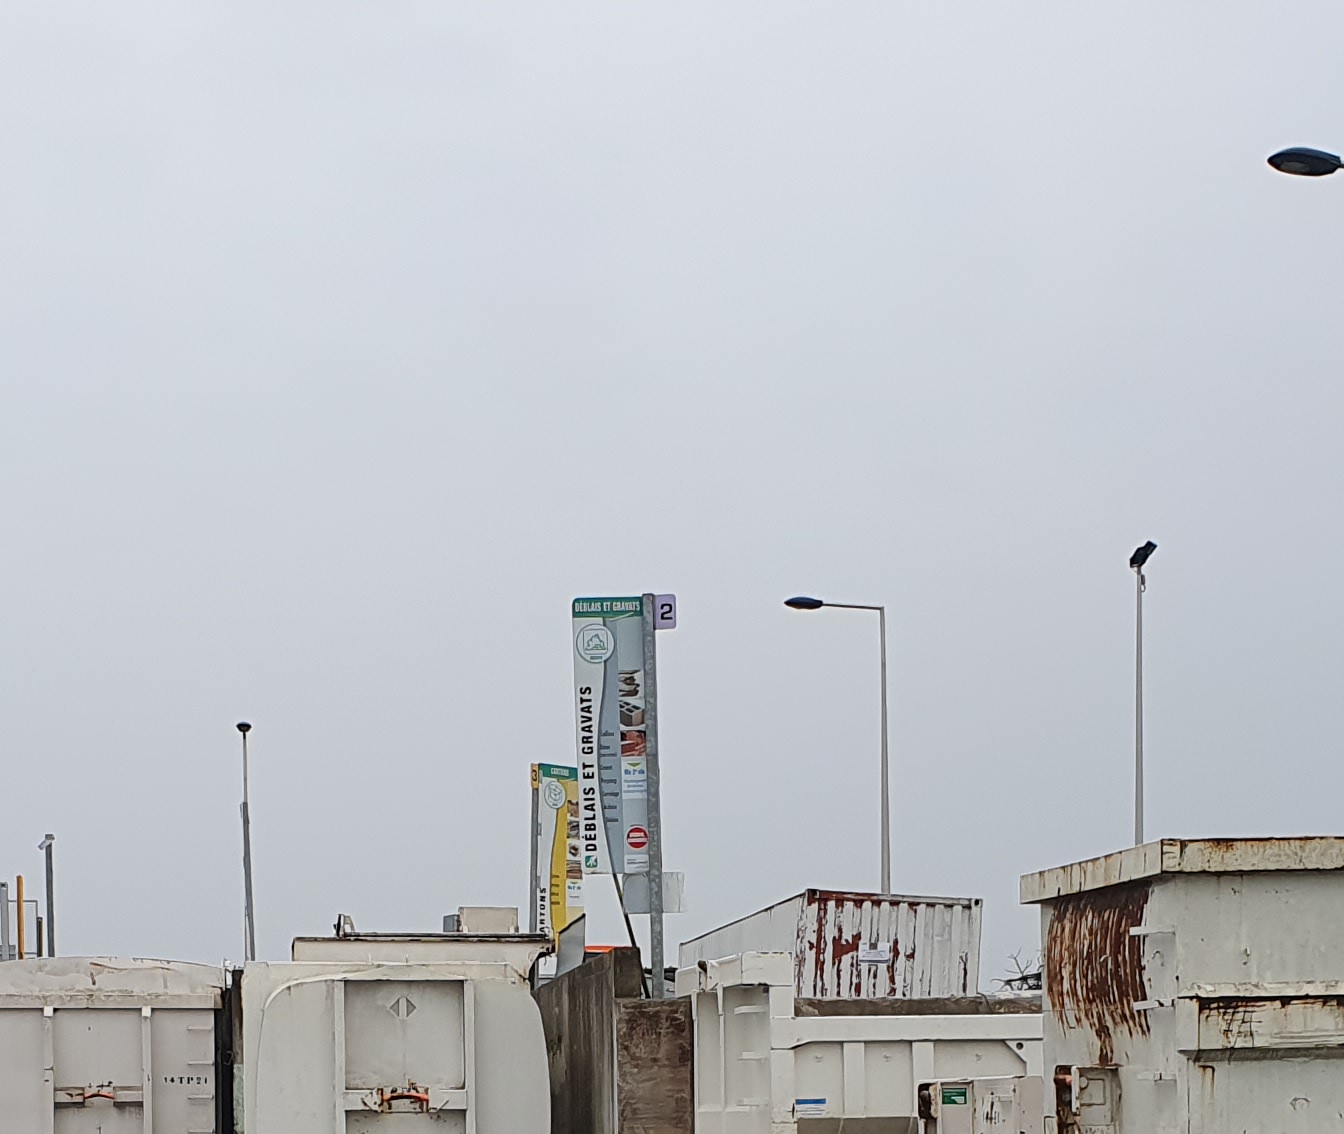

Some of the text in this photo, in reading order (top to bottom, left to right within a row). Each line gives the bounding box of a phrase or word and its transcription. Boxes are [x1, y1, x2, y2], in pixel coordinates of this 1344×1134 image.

[660, 603, 674, 620] 2
[579, 686, 597, 852] DÉBLAIS ET GRAVATS
